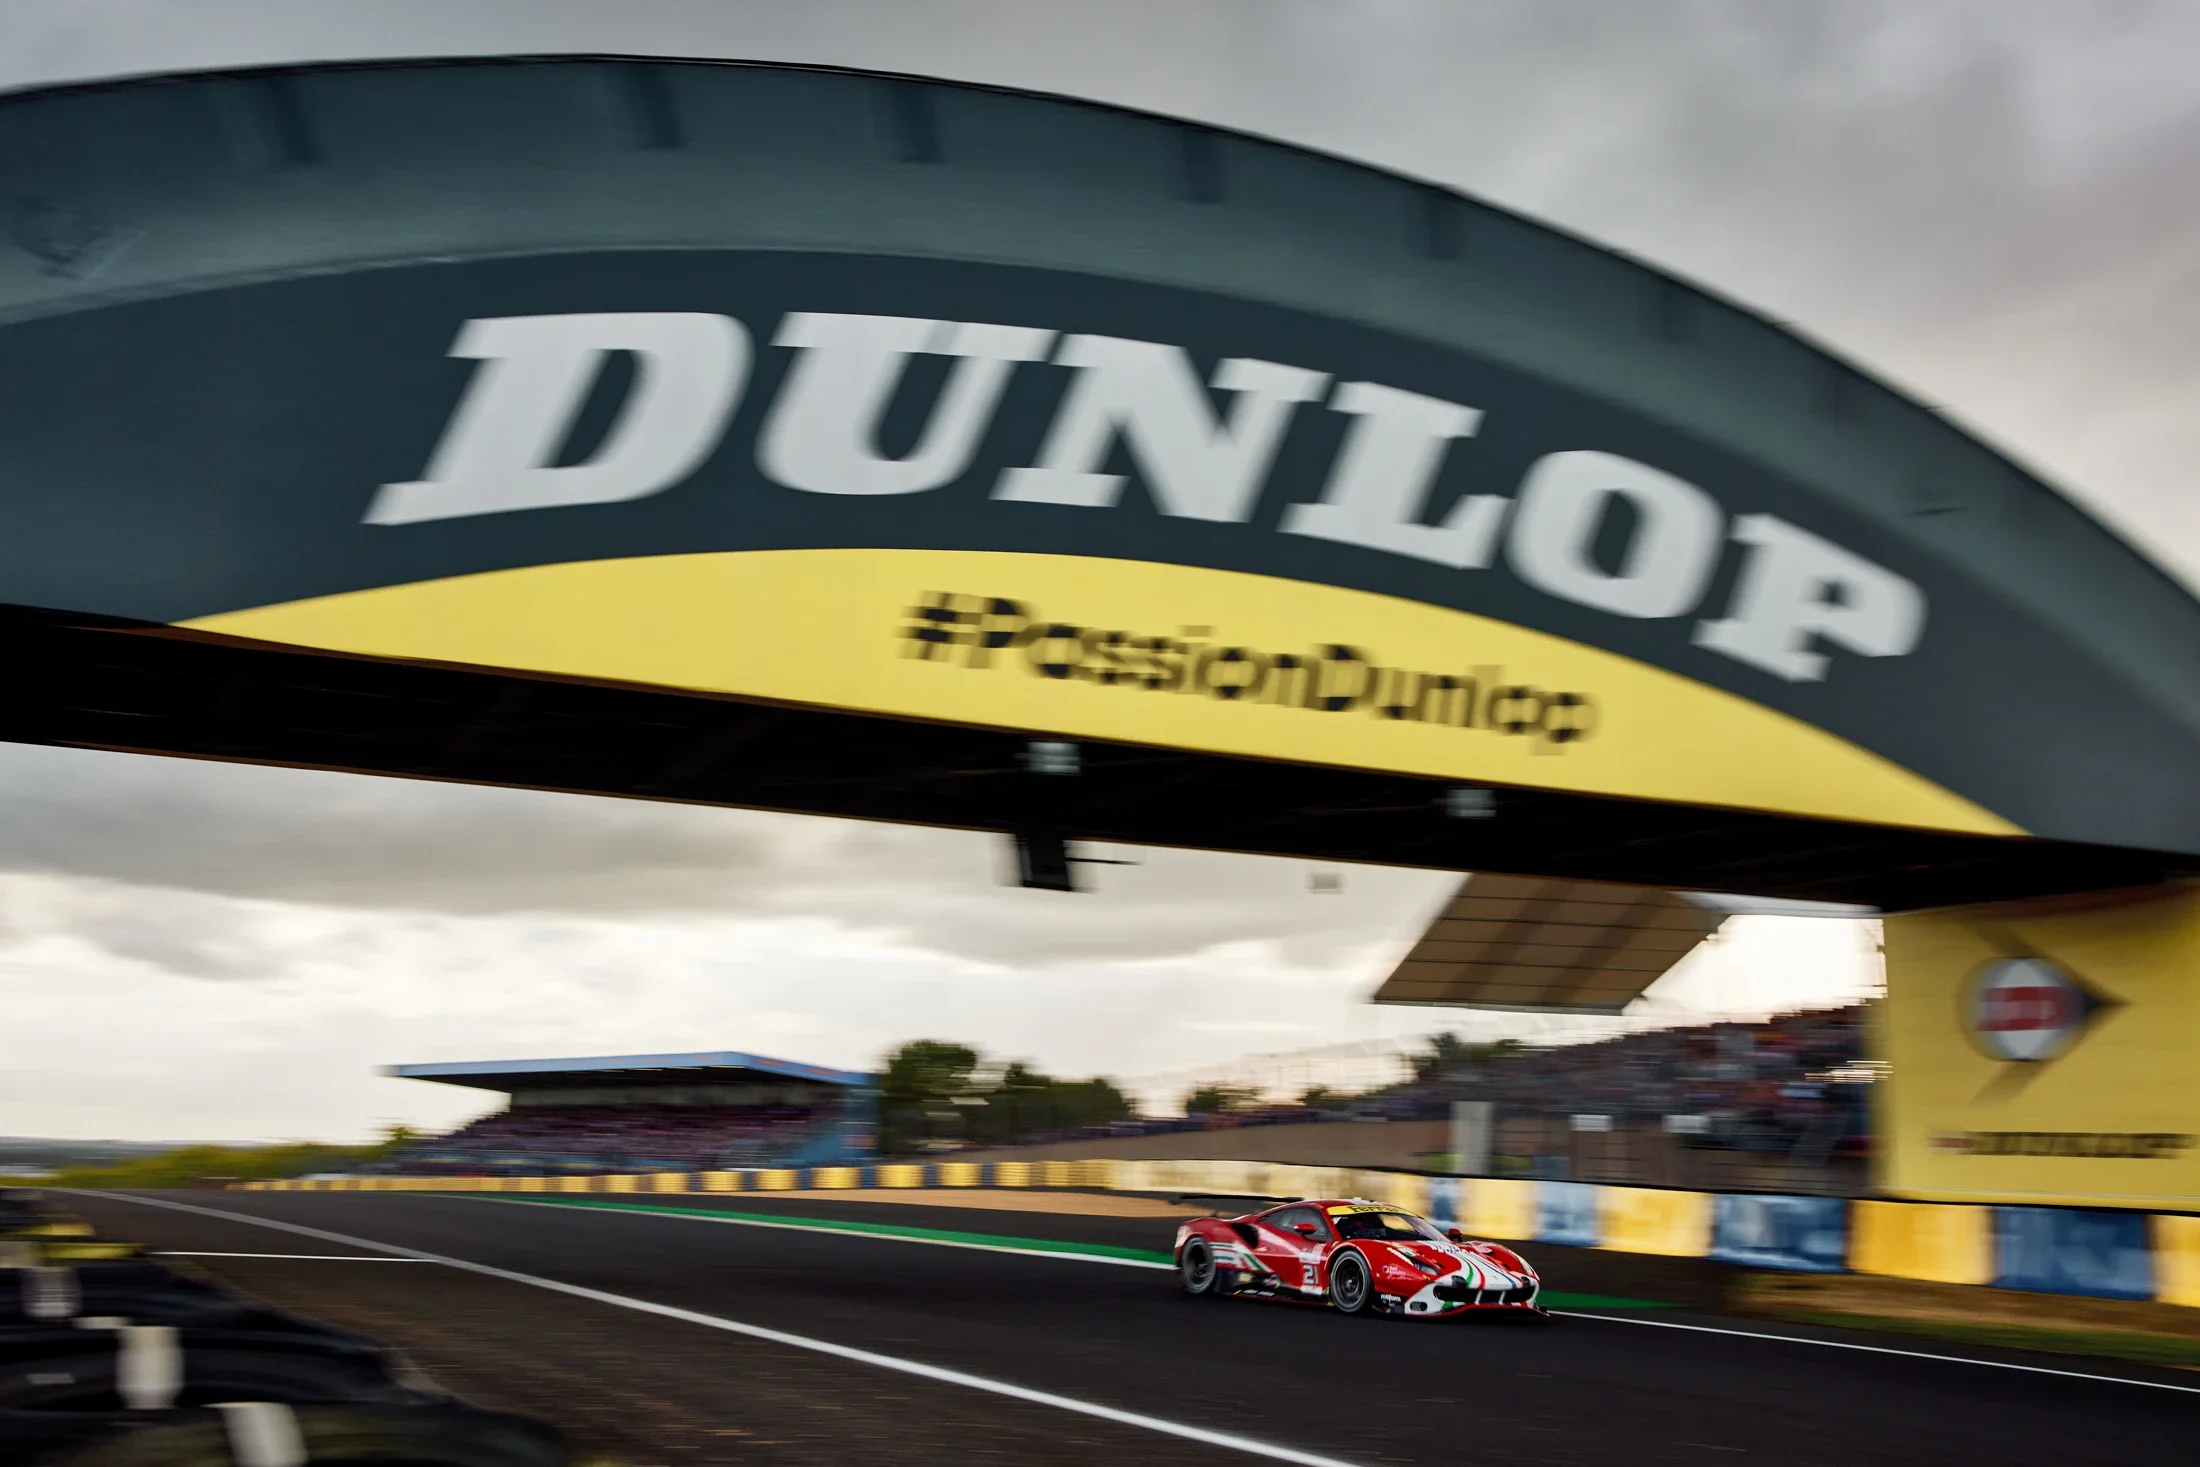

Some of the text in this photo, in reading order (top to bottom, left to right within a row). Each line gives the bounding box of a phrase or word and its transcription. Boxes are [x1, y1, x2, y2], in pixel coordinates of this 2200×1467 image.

[362, 311, 1926, 683] DUNLOP
[898, 590, 1599, 755] #PassionDunlop
[1303, 1264, 1319, 1285] 21
